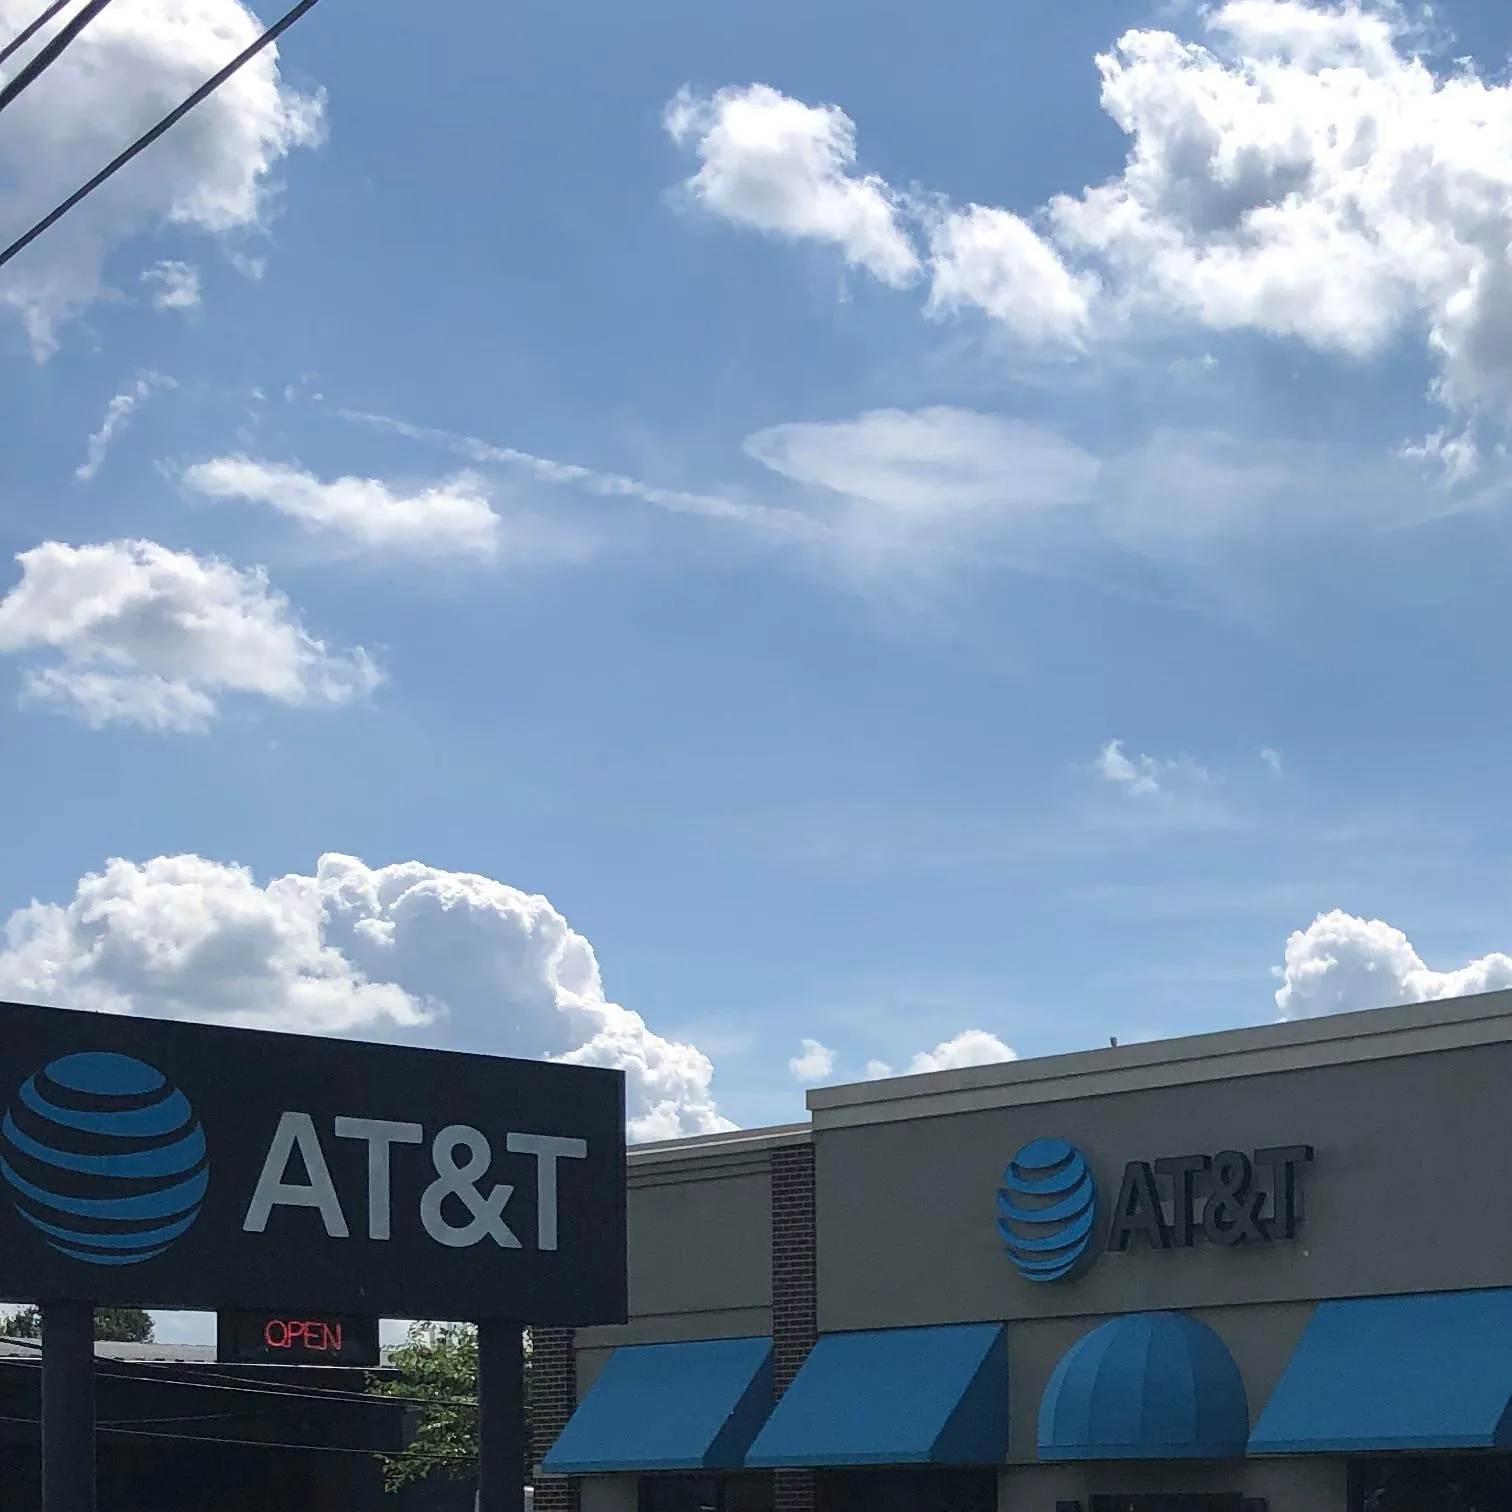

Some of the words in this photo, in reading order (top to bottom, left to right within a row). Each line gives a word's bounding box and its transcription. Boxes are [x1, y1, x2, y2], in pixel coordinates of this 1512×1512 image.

[243, 1111, 588, 1250] AT&T
[1107, 1145, 1314, 1252] AT&T
[265, 1319, 342, 1350] OPEN
